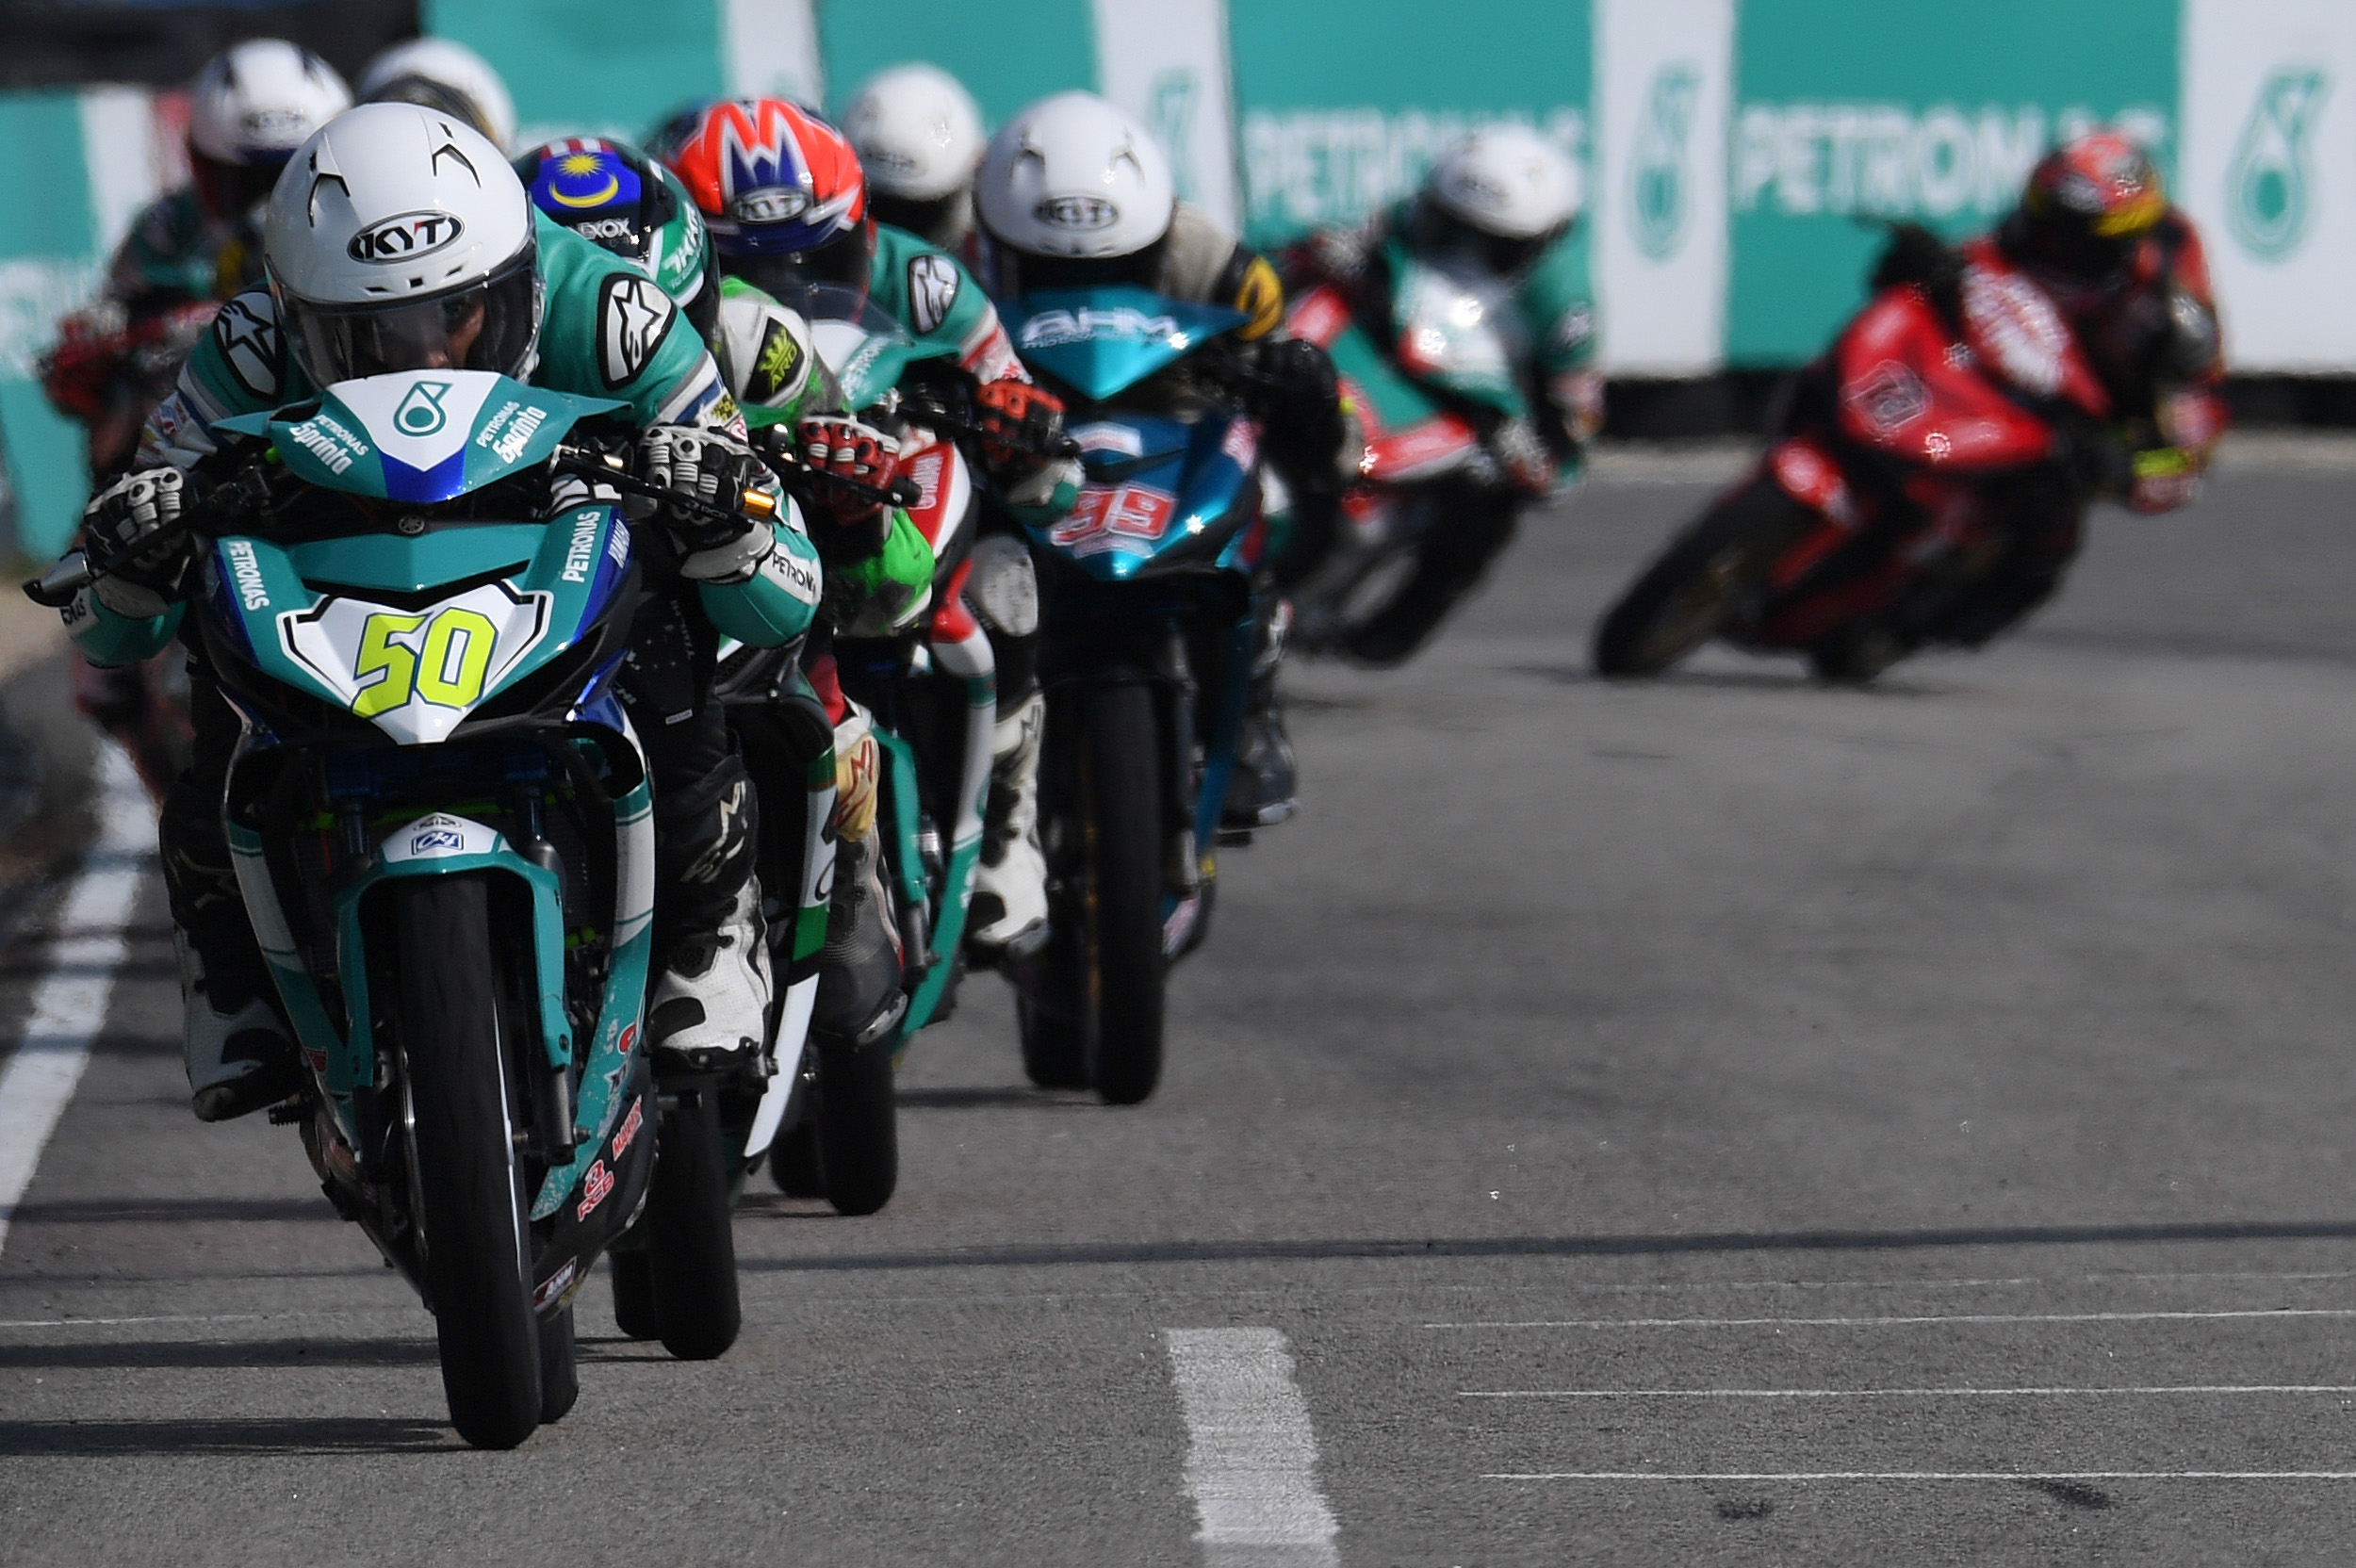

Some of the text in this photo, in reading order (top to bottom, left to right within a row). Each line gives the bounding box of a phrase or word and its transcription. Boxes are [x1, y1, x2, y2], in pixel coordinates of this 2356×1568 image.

[1734, 102, 2165, 215] PETRON
[356, 216, 450, 260] KYT
[289, 423, 352, 475] Sprinta
[314, 415, 369, 456] PETRONAS
[476, 400, 520, 448] PETRONAS
[493, 406, 548, 464] Sprinta
[562, 511, 601, 583] PETRONAS
[227, 540, 270, 612] PETRONAS
[351, 606, 499, 719] 50
[578, 1170, 614, 1222] RCB
